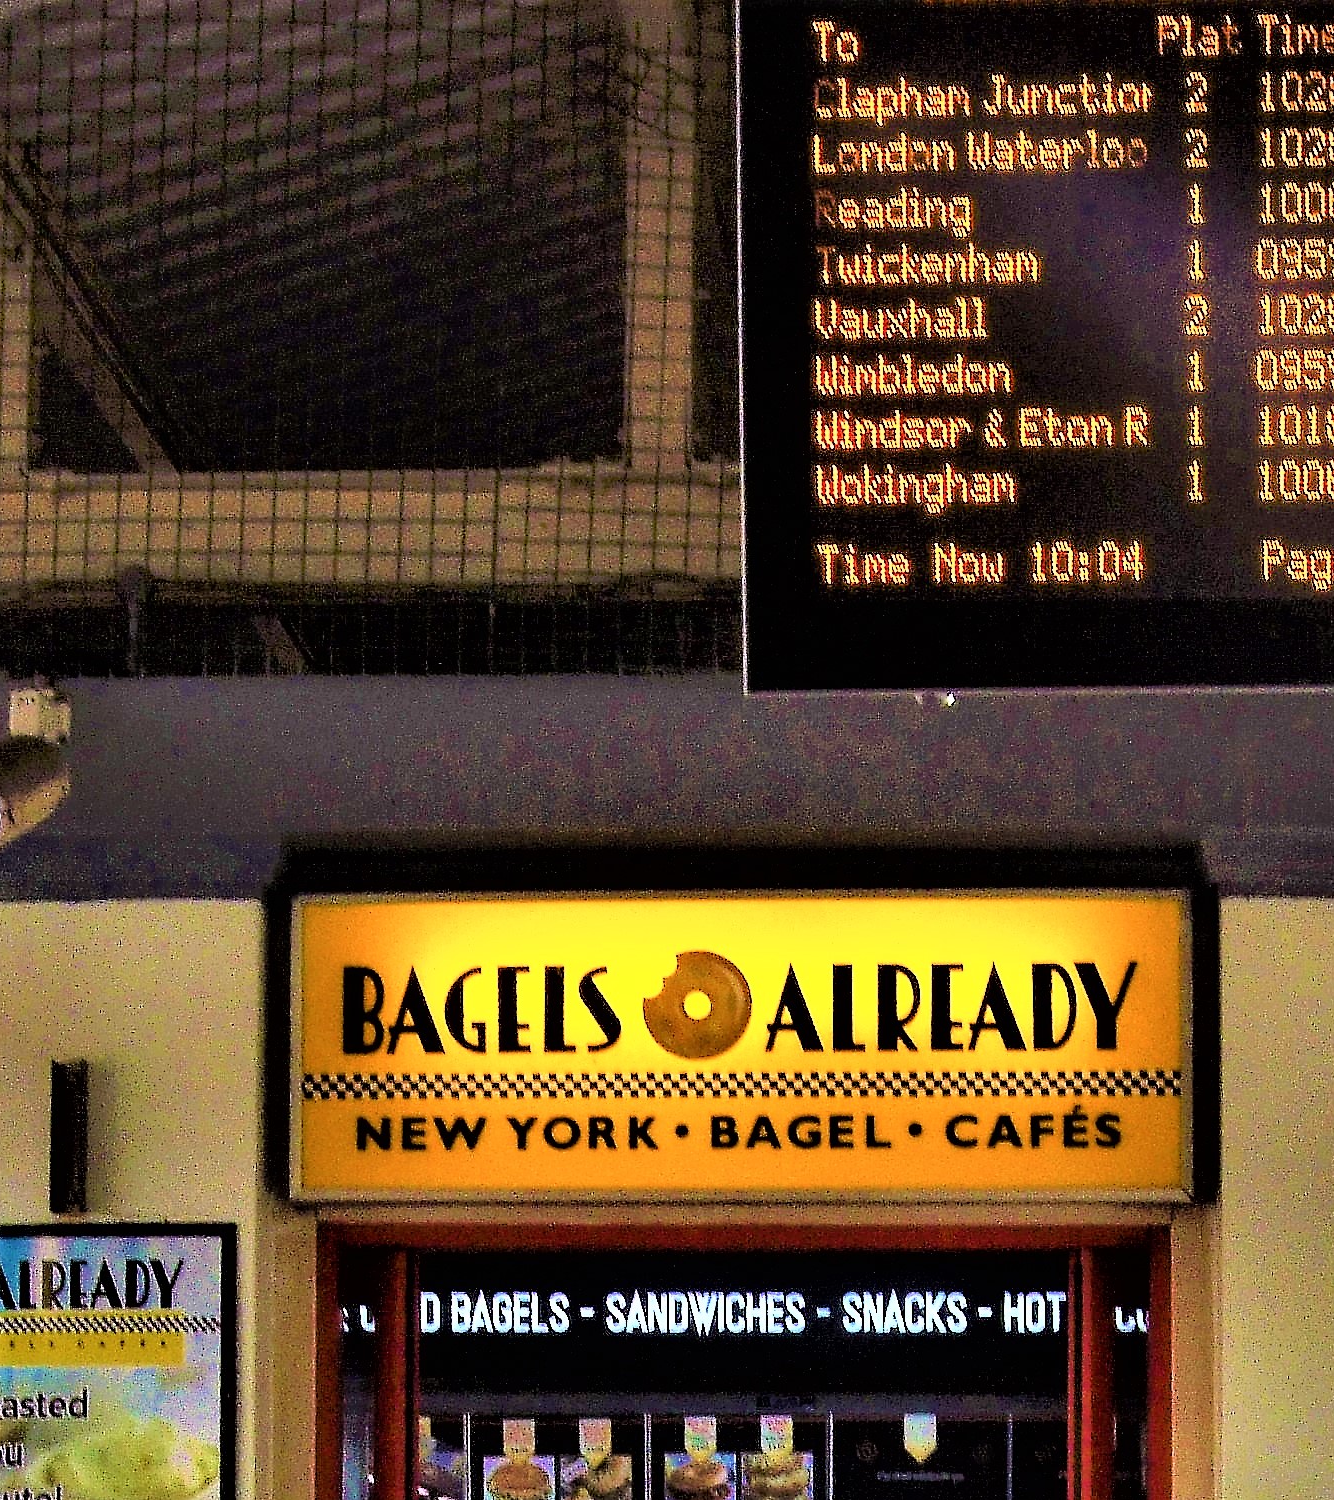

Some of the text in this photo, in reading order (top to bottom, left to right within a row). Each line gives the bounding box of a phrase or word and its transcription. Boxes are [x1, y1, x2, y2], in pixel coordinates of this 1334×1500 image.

[813, 20, 858, 62] To
[1158, 14, 1241, 56] Plat
[814, 75, 970, 126] Clapham
[1184, 71, 1207, 113] 2
[813, 132, 955, 174] London
[967, 129, 1148, 171] Waterloo
[1184, 127, 1208, 168] 2
[815, 187, 971, 239] Reading
[1188, 182, 1205, 225] 1
[816, 243, 1038, 285] Twickenham
[1188, 239, 1204, 280] 1
[814, 297, 987, 340] Vauxhall
[1184, 294, 1209, 336] 2
[815, 353, 1012, 395] Wimbledon
[1187, 349, 1204, 392] 1
[815, 410, 972, 449] Windsor
[984, 408, 1006, 447] &
[1019, 408, 1114, 447] Eton
[1125, 406, 1149, 447] R
[1187, 405, 1204, 446] 1
[815, 464, 1015, 514] Wokingham
[1187, 459, 1204, 501] 1
[817, 543, 909, 584] Time
[933, 543, 1004, 582] Now
[1031, 541, 1144, 581] 10:04
[342, 961, 1139, 1055] BAGELS ALREADY
[355, 1103, 1123, 1151] NEW YORK BAGEL CAFÉS
[451, 1289, 570, 1334] BAGELS
[605, 1290, 806, 1334] SANDWICHES
[842, 1290, 968, 1334] SNACKS
[1003, 1290, 1066, 1334] HOT
